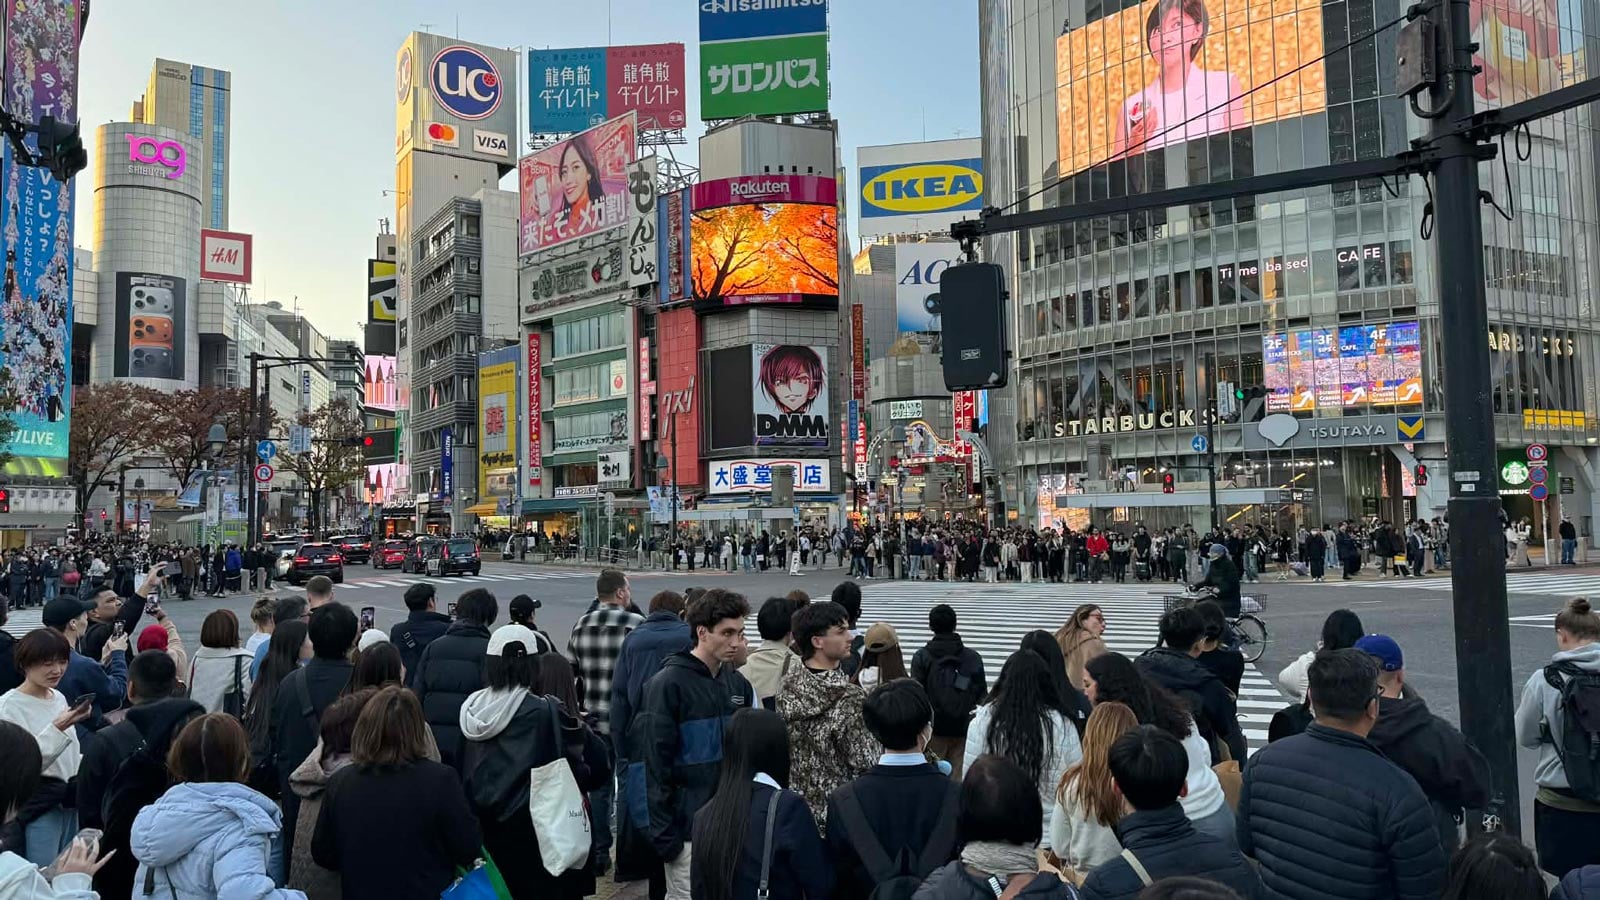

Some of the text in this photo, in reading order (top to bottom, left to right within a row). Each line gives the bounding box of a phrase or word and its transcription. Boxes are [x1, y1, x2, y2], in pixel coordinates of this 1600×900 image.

[438, 61, 495, 102] UC
[545, 64, 592, 87] 龍角散
[623, 61, 670, 84] 龍角散
[708, 58, 820, 95] サロンパス
[538, 86, 600, 109] ダイレクト
[617, 84, 679, 106] ダイレクト
[476, 135, 507, 150] VISA
[125, 133, 187, 179] 109
[128, 164, 166, 177] SHIBUYA
[731, 180, 790, 195] Rakuten
[874, 174, 977, 201] IKEA
[523, 190, 626, 249] 来たぞ、メガ割
[629, 161, 655, 281] もんじゃ
[211, 247, 239, 265] H&M
[1219, 247, 1381, 280] Time based CAFE
[899, 259, 952, 285] AC
[1267, 338, 1282, 349] 2F
[1318, 334, 1333, 345] 3F
[1370, 328, 1387, 340] 4F
[1488, 331, 1574, 356] ARBUCKS
[1268, 350, 1302, 358] STARBCKS
[661, 375, 696, 438] クスリ
[1055, 408, 1217, 437] STARBUCKS
[1309, 425, 1386, 438] TSUTAYA
[715, 465, 822, 487] 大盛堂店
